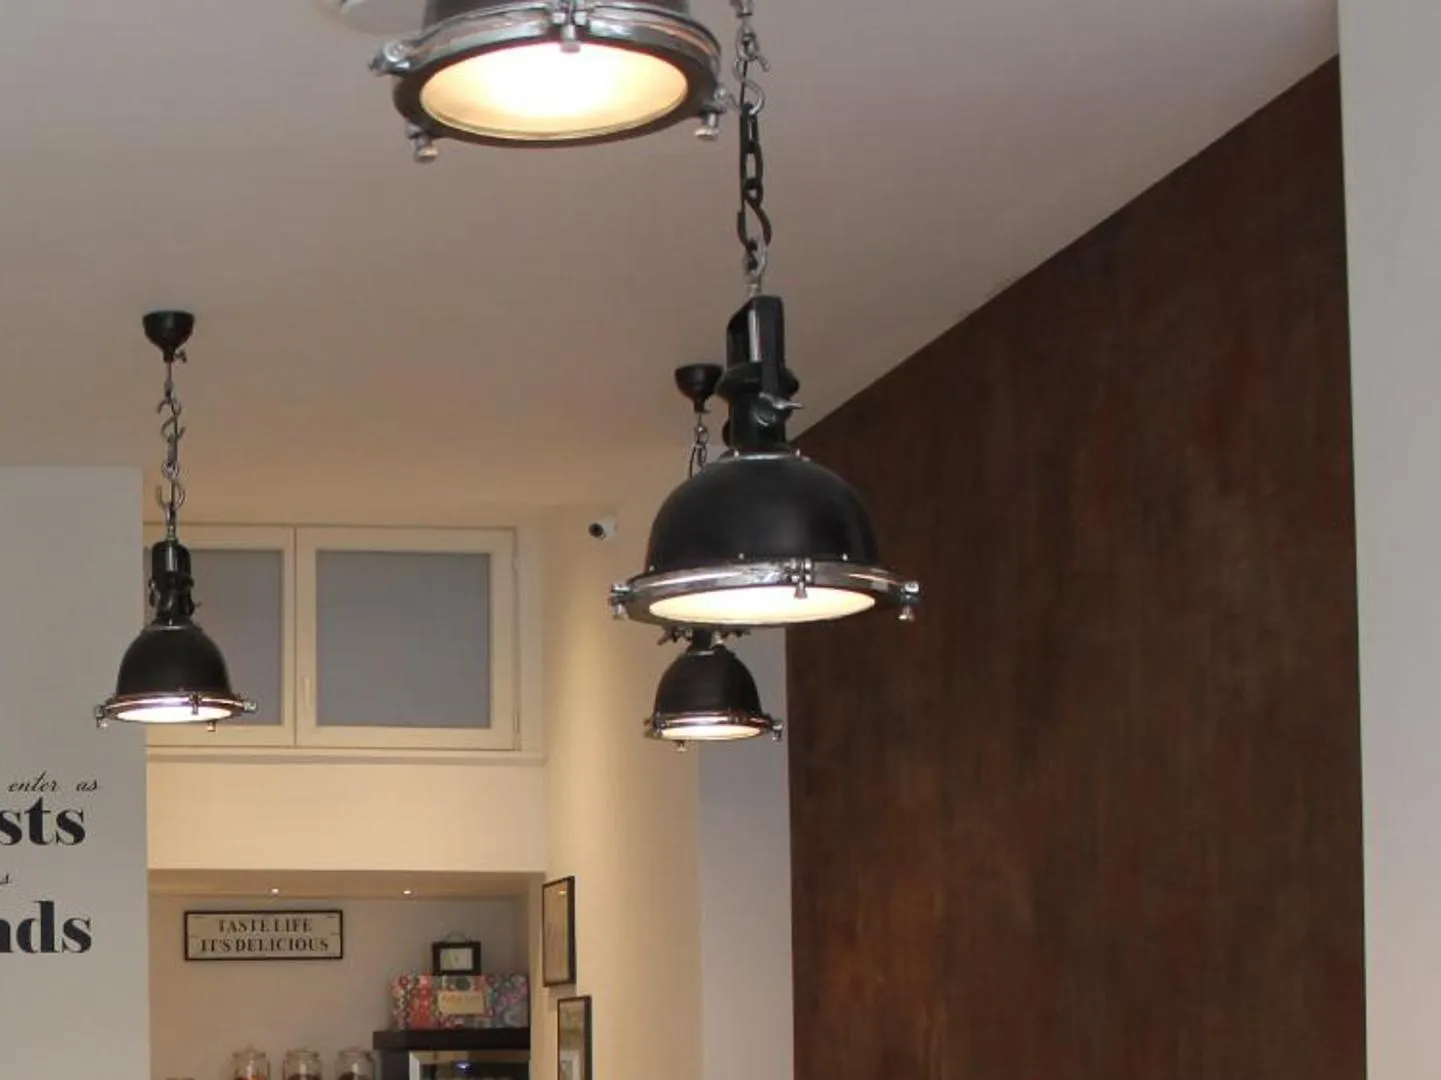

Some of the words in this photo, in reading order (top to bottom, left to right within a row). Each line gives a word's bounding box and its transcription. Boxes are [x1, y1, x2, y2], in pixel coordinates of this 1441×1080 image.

[8, 770, 60, 793] enter
[75, 779, 100, 793] as
[274, 916, 313, 933] LIFE
[235, 936, 329, 953] DELICIOUS
